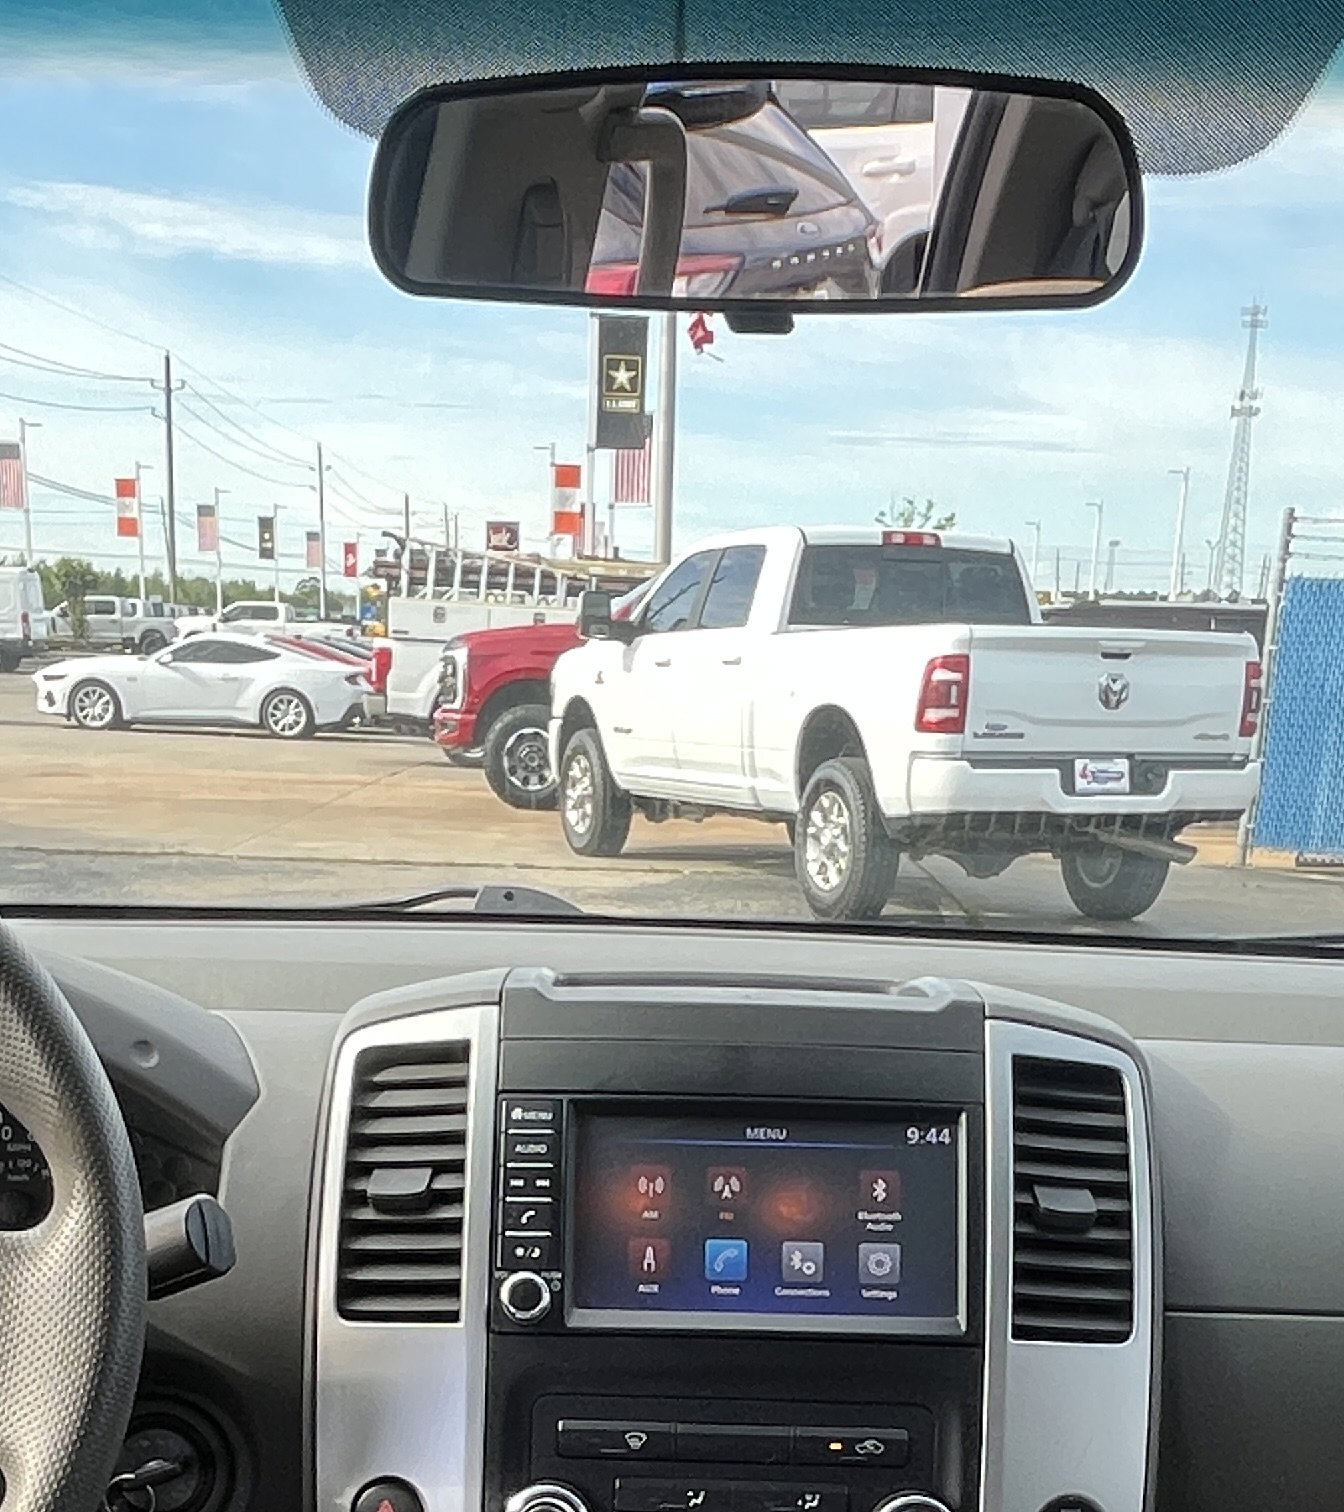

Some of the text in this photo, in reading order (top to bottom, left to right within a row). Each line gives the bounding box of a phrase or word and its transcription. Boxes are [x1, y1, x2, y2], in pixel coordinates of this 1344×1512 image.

[745, 1127, 788, 1140] MENU
[906, 1126, 952, 1145] 9:44
[514, 1143, 548, 1154] AUDIO
[865, 1222, 894, 1232] Audio
[710, 1285, 741, 1295] Phone
[774, 1286, 831, 1297] Connections
[860, 1288, 898, 1301] Settings
